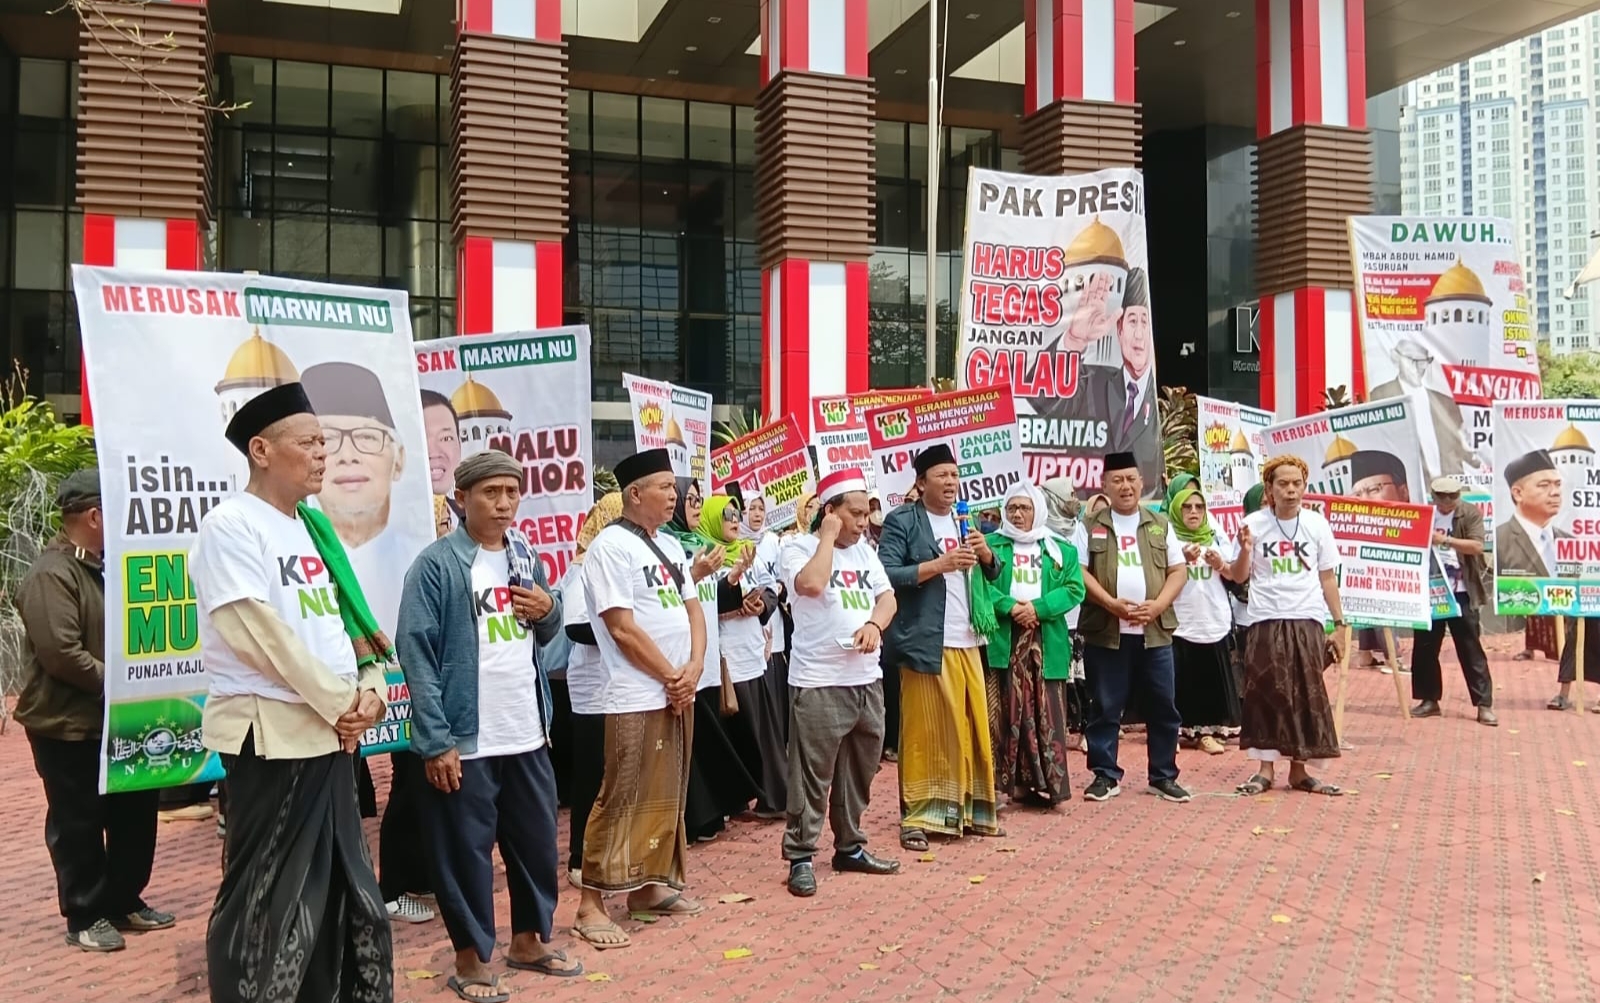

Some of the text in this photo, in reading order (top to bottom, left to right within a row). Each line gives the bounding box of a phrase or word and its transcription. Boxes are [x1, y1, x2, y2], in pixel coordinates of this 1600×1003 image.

[979, 183, 1044, 217] PAK
[973, 243, 1064, 279] HARUS
[1363, 252, 1455, 260] MBAH ABDUL HAMID
[1364, 263, 1408, 271] PASURUAN
[102, 285, 388, 327] MERUSAK MARWAH NU
[971, 281, 1063, 325] TEGAS
[1381, 295, 1417, 305] Indonesia
[968, 329, 1043, 345] JANGAN
[464, 342, 543, 367] MARWAH
[548, 340, 573, 358] NU
[966, 349, 1082, 398] GALAU
[1451, 369, 1541, 401] TANGKAP
[822, 401, 847, 413] KPK
[854, 395, 884, 406] BERANI
[877, 391, 1000, 428] KPK BERANI MENJAGA
[1504, 407, 1564, 419] MERUSAK
[640, 408, 664, 426] WOW!
[827, 413, 844, 423] NU
[884, 402, 996, 438] NU DAN MENGAWAL
[918, 414, 986, 434] MARTABAT NU
[1272, 420, 1329, 444] MERUSAK
[1332, 410, 1384, 430] MARWAH
[1386, 405, 1403, 418] NU
[821, 434, 845, 446] SEGERA
[960, 430, 1011, 449] JANGAN
[1018, 418, 1108, 447] BRANTAS
[1204, 427, 1230, 446] WOW!
[488, 428, 578, 463] MALU
[711, 454, 731, 470] KPK
[733, 438, 757, 455] BERANI
[757, 424, 788, 443] MENJAGA
[961, 440, 1013, 459] GALAU
[717, 467, 730, 479] NU
[736, 451, 749, 462] DAN
[749, 433, 788, 457] MENGAWAL
[738, 445, 784, 470] MARTABAT NU
[127, 455, 229, 492] isin...
[757, 452, 806, 485] OKNUM
[765, 470, 808, 497] ANNASIR
[776, 485, 803, 506] JAHAT
[1331, 502, 1369, 514] BERANI
[1371, 507, 1420, 519] MENJAGA
[1330, 513, 1413, 529] DAN MENGAWAL
[1330, 523, 1400, 538] MARTABAT NU
[1263, 541, 1310, 558] KPK
[1361, 547, 1405, 561] MARWAH
[1406, 553, 1421, 563] NU
[277, 554, 335, 587] KP
[1013, 568, 1038, 584] NU
[1187, 566, 1213, 580] NU
[1272, 559, 1302, 575] NU
[1347, 566, 1420, 580] YANG MENERIMA
[830, 569, 872, 588] KPK
[1346, 575, 1373, 589] UANG
[1376, 579, 1421, 594] RISYWAH
[698, 583, 716, 602] NU
[840, 589, 870, 610] NU
[1547, 588, 1573, 599] KPK
[1552, 597, 1569, 606] NU
[298, 586, 339, 619] NU
[1437, 603, 1450, 613] NU
[127, 604, 199, 655] MU
[487, 616, 528, 644] NU
[128, 662, 173, 681] PUNAPA
[124, 757, 192, 776] N U
